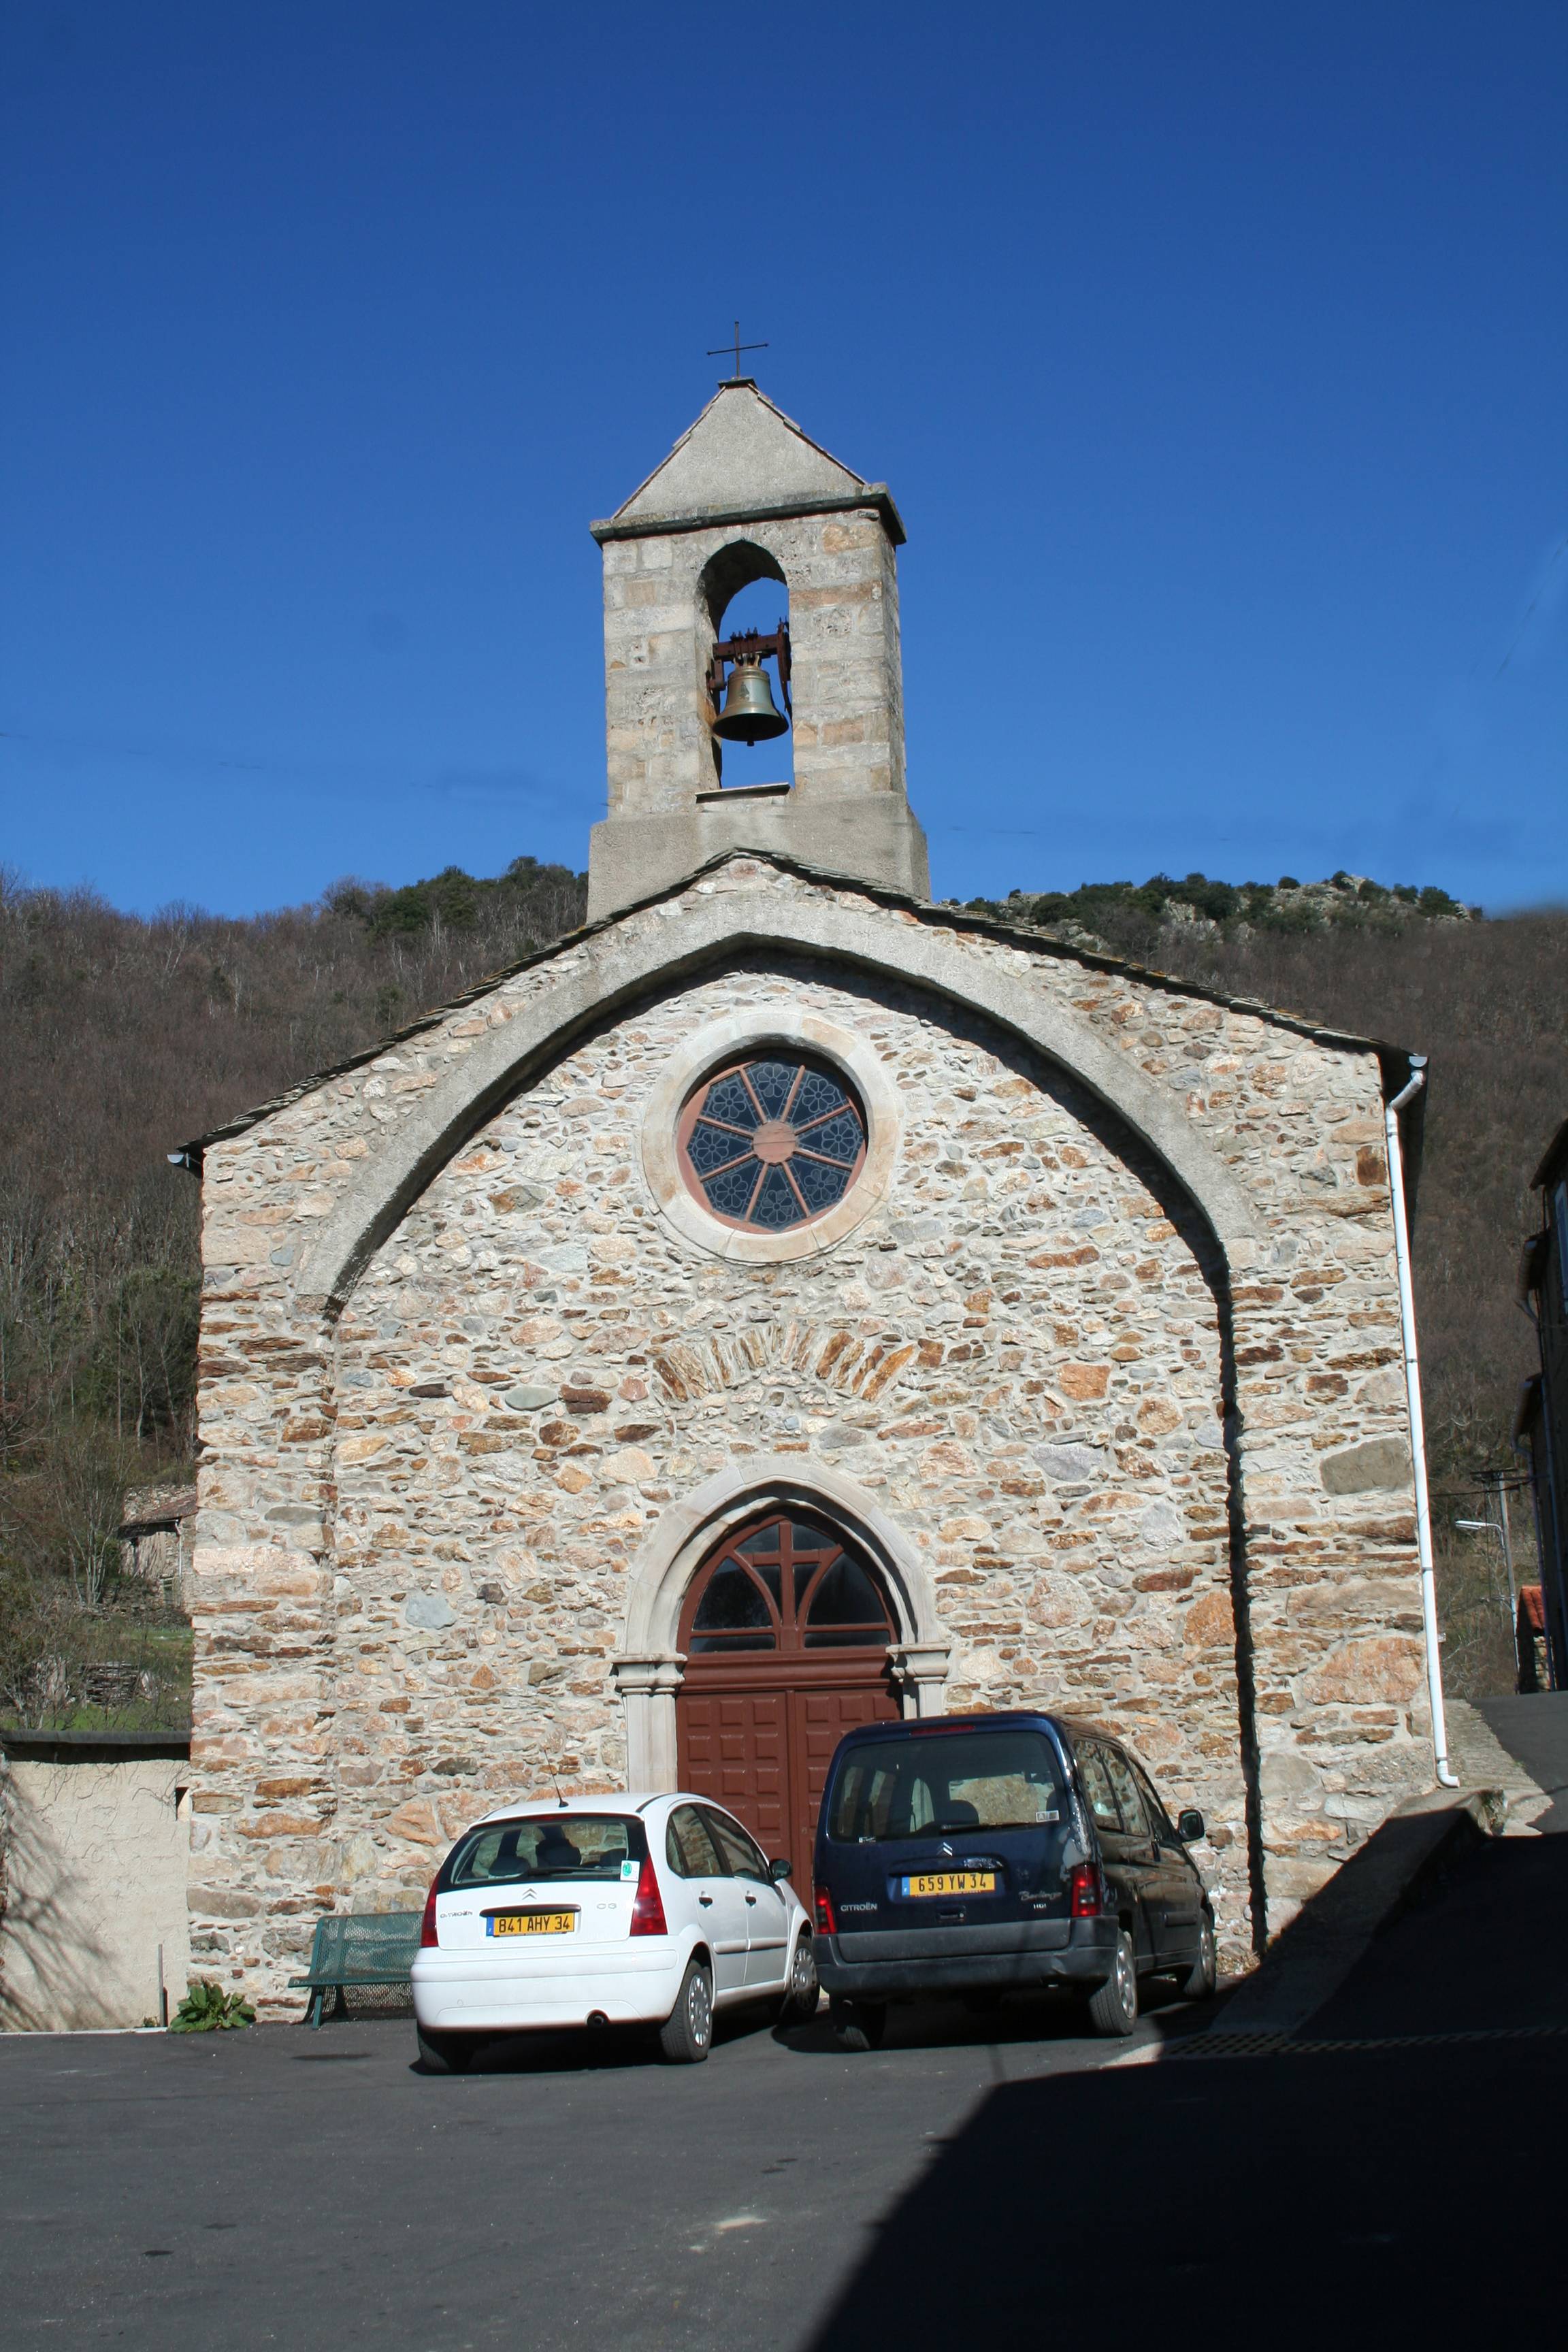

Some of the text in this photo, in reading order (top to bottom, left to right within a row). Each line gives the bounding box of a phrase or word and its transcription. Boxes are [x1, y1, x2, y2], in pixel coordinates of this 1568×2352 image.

[919, 1874, 985, 1892] 659 YW 34
[840, 1902, 877, 1912] CITROËN
[499, 1915, 570, 1933] 841 AHY 34
